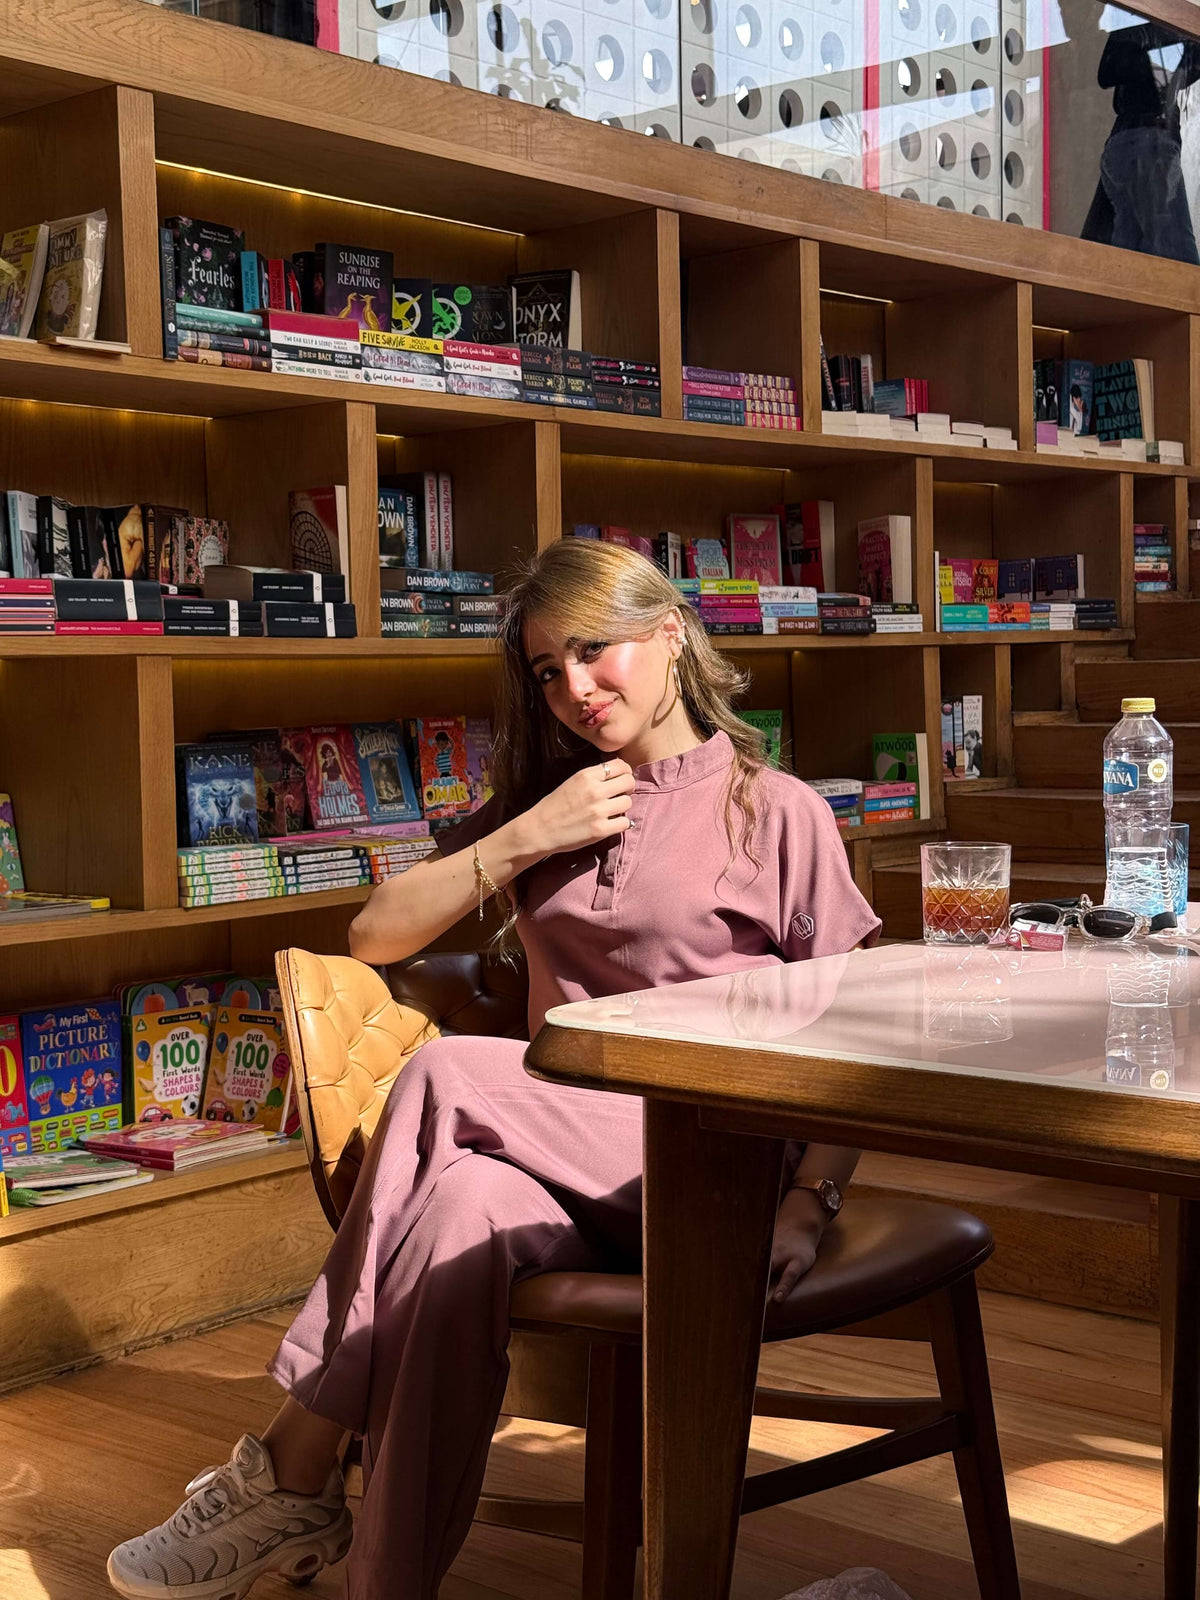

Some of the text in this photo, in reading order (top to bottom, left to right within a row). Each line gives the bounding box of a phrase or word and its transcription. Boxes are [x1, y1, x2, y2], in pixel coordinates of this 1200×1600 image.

[338, 251, 380, 268] SUNRISE
[347, 266, 371, 276] ON THE
[337, 272, 381, 290] REAPING
[362, 332, 380, 344] FIVE
[516, 331, 563, 347] TORM
[318, 352, 333, 361] BACK
[1096, 390, 1139, 416] TWO
[378, 496, 395, 510] AN
[378, 511, 404, 529] OWN
[406, 496, 415, 547] DAN BROWN
[696, 556, 727, 568] STORIES
[702, 567, 723, 577] ITALIAN
[407, 576, 450, 588] DAN BROWN
[975, 587, 994, 597] SILVER
[380, 598, 414, 608] AN BROWN
[460, 601, 498, 612] DAN BROWN
[380, 621, 419, 632] DAN BROWN
[460, 623, 498, 633] DAN BROWN
[875, 741, 915, 751] ATWOOD
[189, 753, 251, 770] KANE
[425, 784, 468, 804] OMAR
[318, 794, 360, 818] HOLMES
[208, 825, 242, 839] RICK
[59, 1013, 89, 1028] My First
[39, 1024, 109, 1051] PICTURE
[170, 1031, 190, 1041] OVER
[246, 1033, 264, 1042] OVER
[28, 1042, 119, 1073] DICTIONARY
[159, 1039, 200, 1070] 100
[235, 1041, 269, 1070] 100
[163, 1066, 201, 1078] First Words
[233, 1068, 266, 1079] First Words
[163, 1075, 194, 1088] SHAPES
[232, 1076, 264, 1089] SHAPES &
[165, 1083, 200, 1097] COLOURS
[231, 1087, 262, 1099] COLOURS
